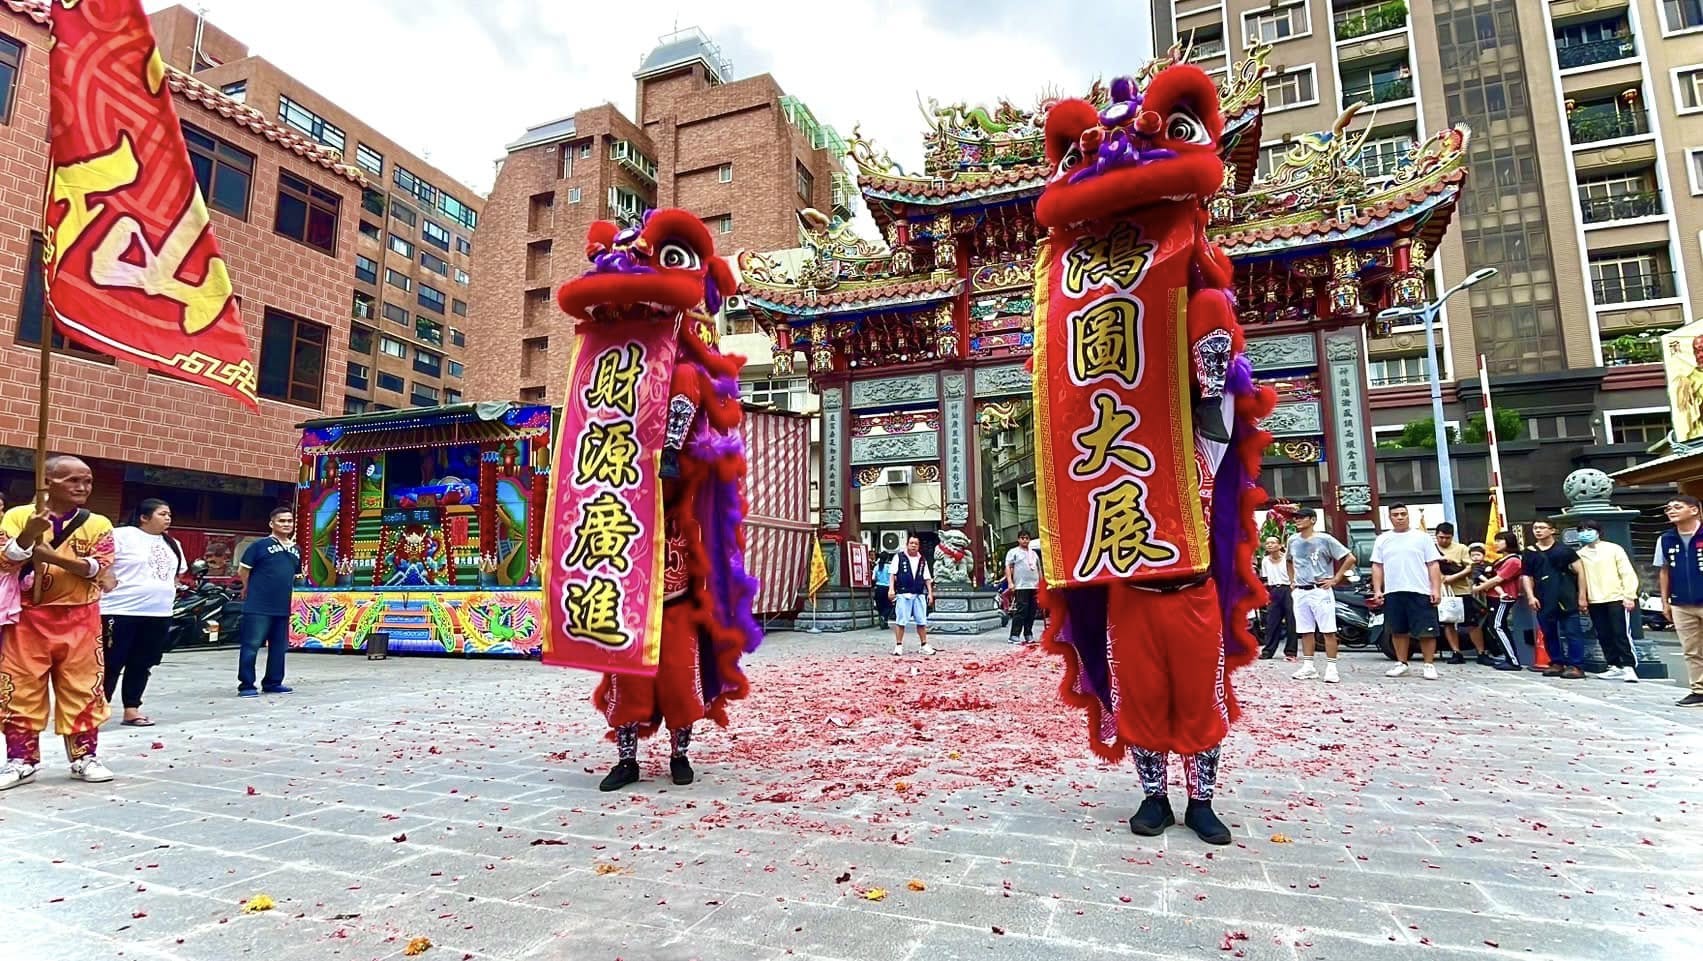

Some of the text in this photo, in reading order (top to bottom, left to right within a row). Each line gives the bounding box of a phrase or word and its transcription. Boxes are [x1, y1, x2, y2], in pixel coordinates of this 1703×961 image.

[563, 342, 646, 650] 財源廣進
[1066, 223, 1175, 579] 鴻圖大展
